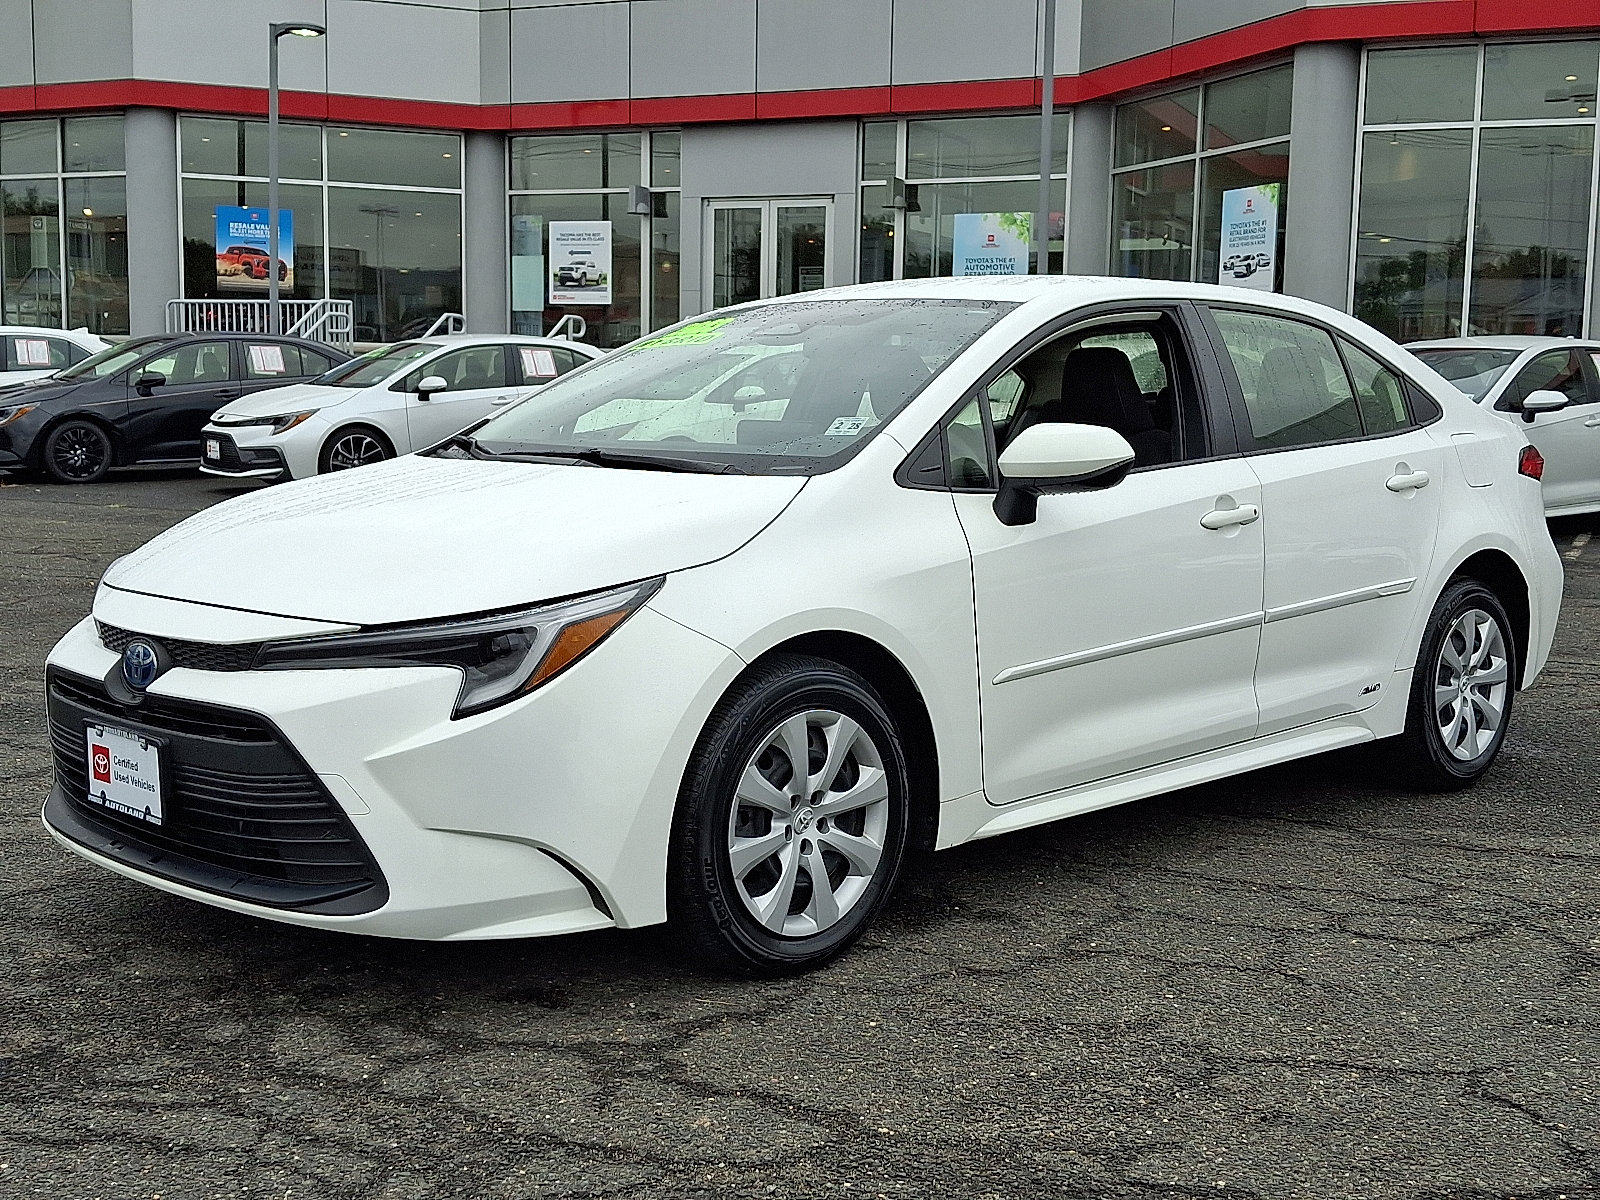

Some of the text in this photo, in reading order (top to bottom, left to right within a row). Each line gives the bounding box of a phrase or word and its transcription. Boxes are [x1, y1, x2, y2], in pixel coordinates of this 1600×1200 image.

[964, 263, 1016, 271] AUTOMOTIVE
[113, 755, 139, 772] Certified
[113, 770, 156, 793] Used Vehicles
[104, 800, 145, 820] AUTOLAND
